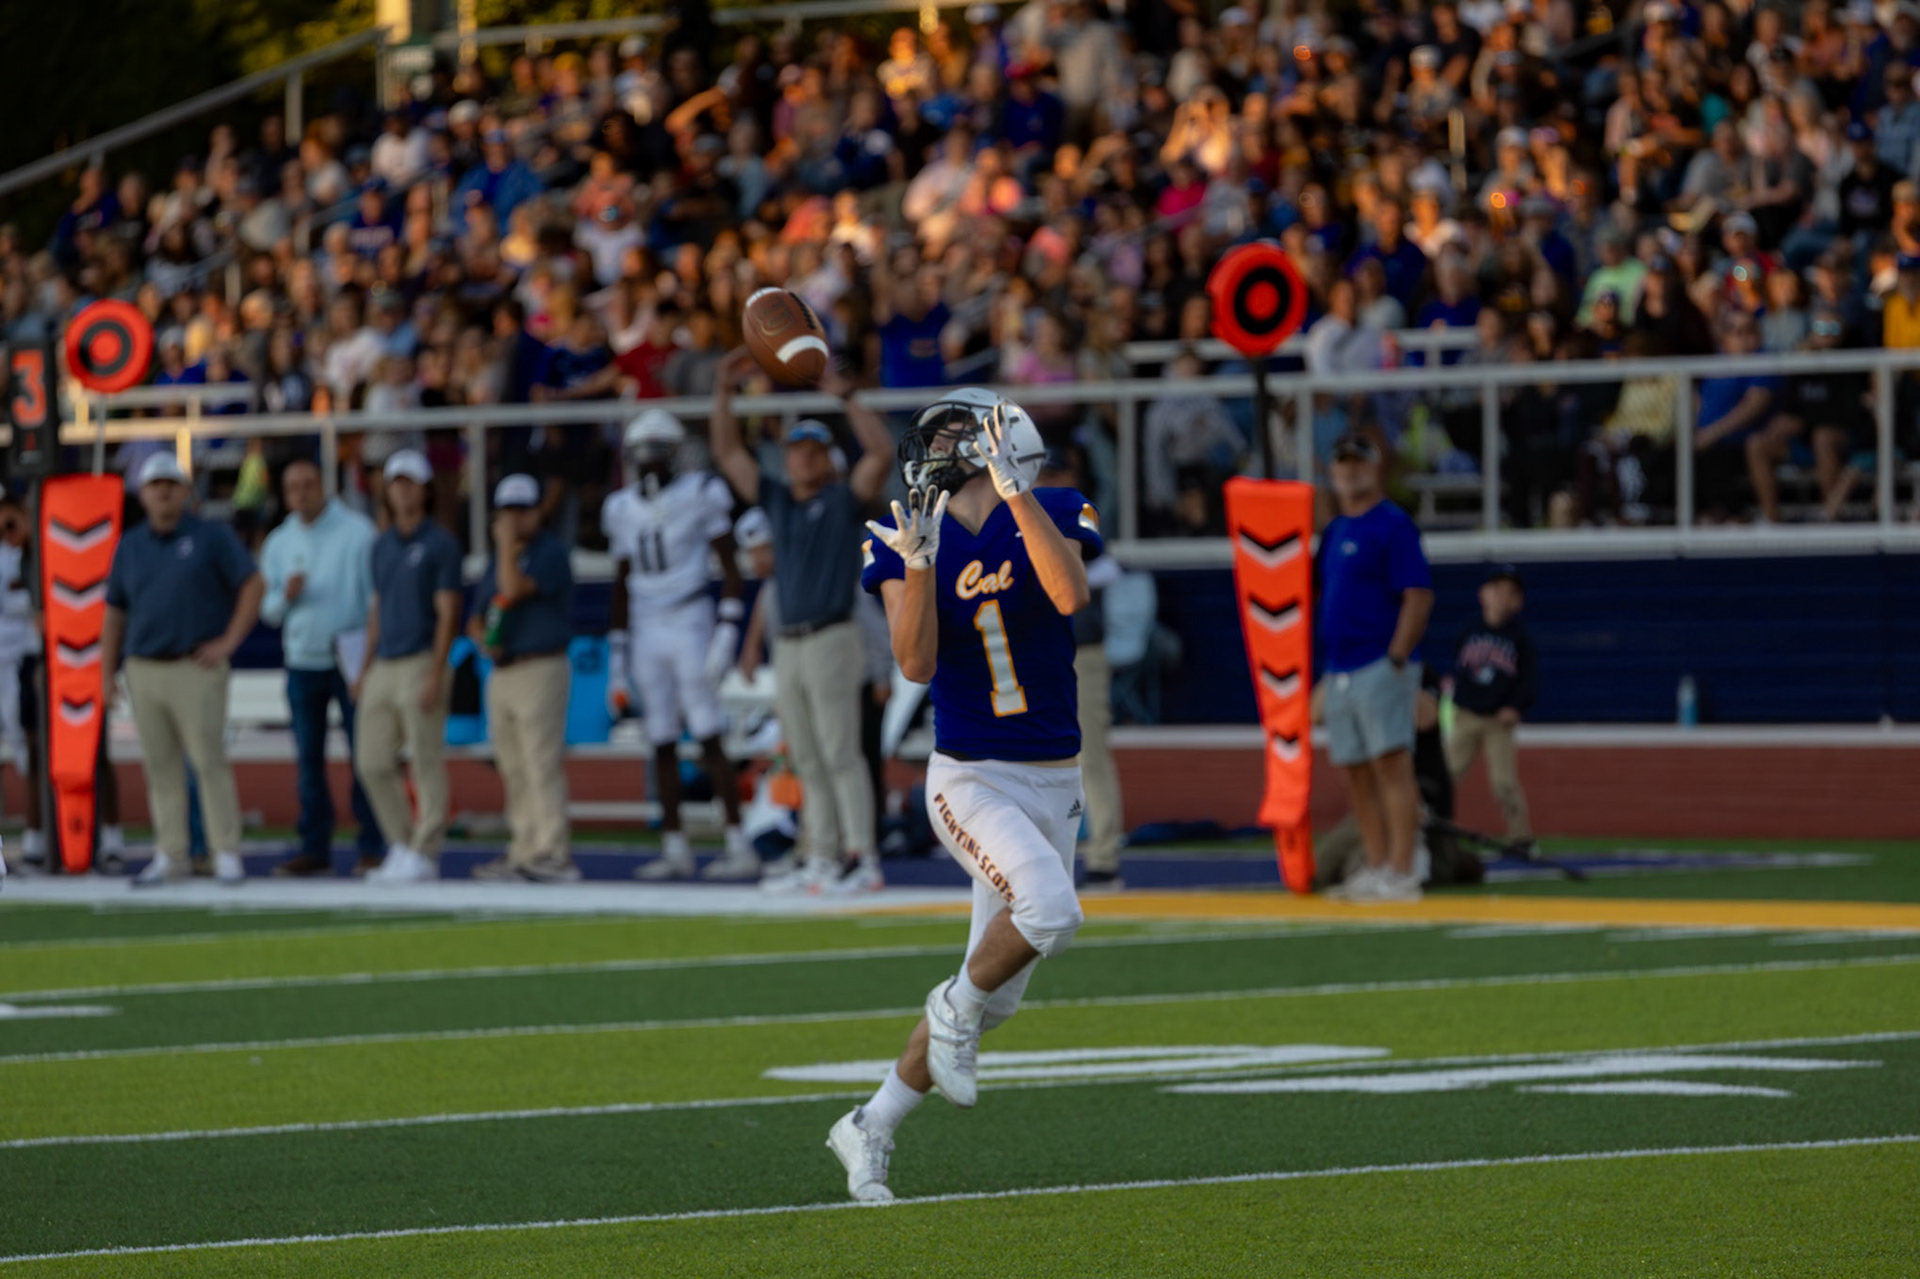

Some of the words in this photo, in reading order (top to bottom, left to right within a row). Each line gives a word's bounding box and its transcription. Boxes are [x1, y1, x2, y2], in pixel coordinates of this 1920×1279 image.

[11, 349, 47, 428] 3
[637, 527, 669, 574] 11
[955, 559, 1015, 600] Cal
[973, 599, 1028, 718] 1
[933, 792, 982, 860] FIGHTING
[978, 852, 1016, 903] SCOTS
